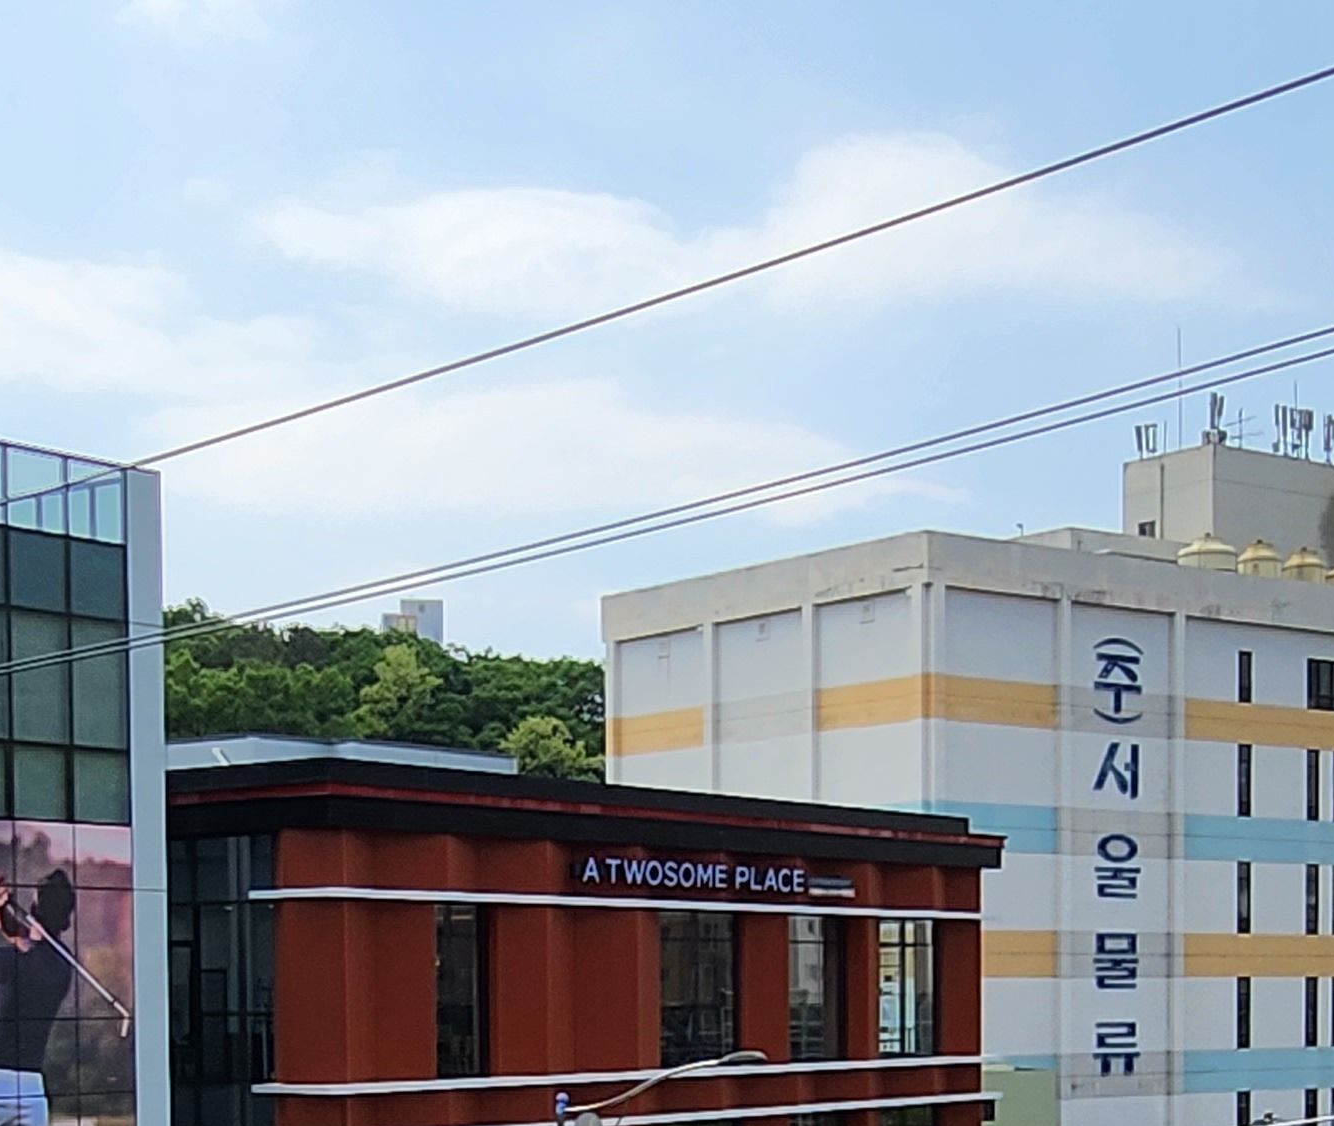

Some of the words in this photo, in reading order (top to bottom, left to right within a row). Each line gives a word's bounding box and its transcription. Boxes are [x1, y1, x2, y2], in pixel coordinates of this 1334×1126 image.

[582, 857, 600, 883] A
[605, 858, 728, 888] TWOSOME
[735, 866, 805, 892] PLACE
